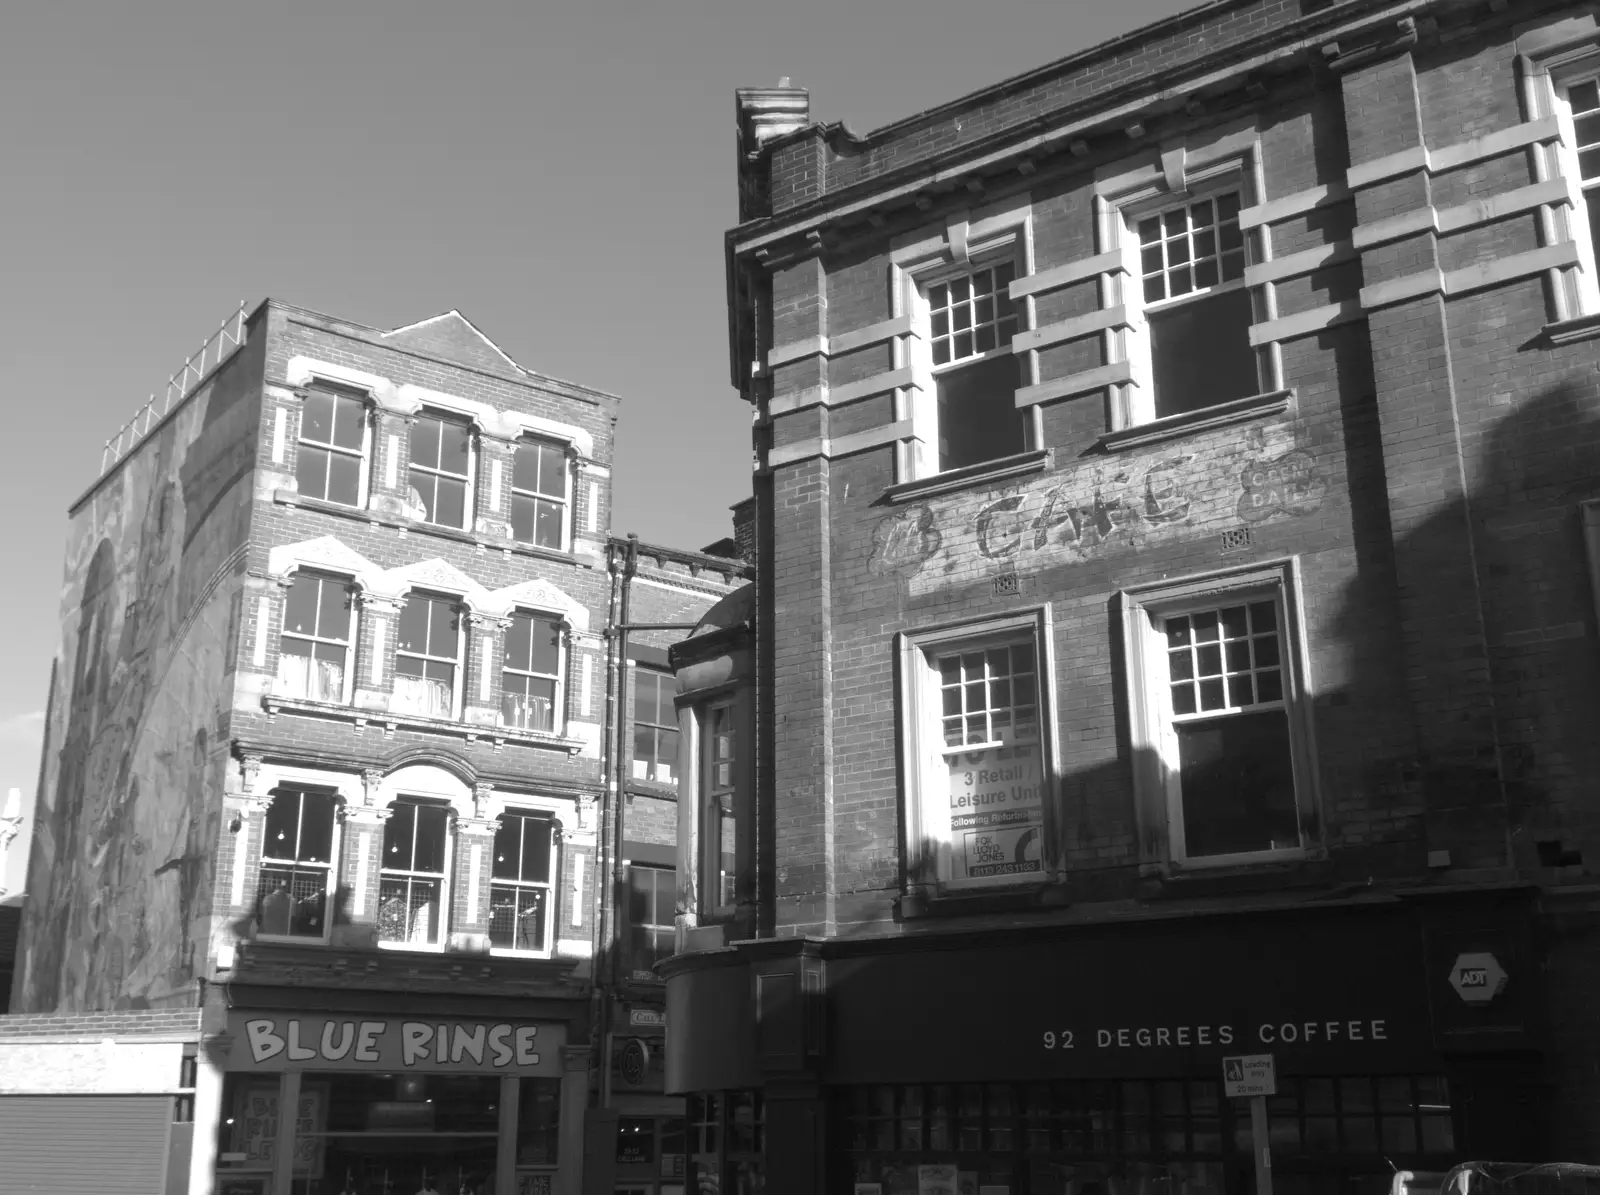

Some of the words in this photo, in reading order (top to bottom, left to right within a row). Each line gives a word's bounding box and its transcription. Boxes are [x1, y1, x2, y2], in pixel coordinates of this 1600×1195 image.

[964, 771, 974, 786] 3
[979, 765, 1022, 784] Retail
[950, 791, 1006, 808] Leisure
[950, 813, 988, 827] Following
[975, 836, 993, 846] FOX
[973, 844, 1000, 855] LLOYD
[976, 852, 1005, 863] JONES
[1461, 970, 1488, 985] ADT
[1043, 1031, 1074, 1049] 92
[1096, 1025, 1234, 1048] DEGREES
[1259, 1020, 1388, 1043] COFFEE
[245, 1019, 387, 1064] BLUE
[402, 1022, 540, 1067] RINSE
[253, 1097, 314, 1117] BLE
